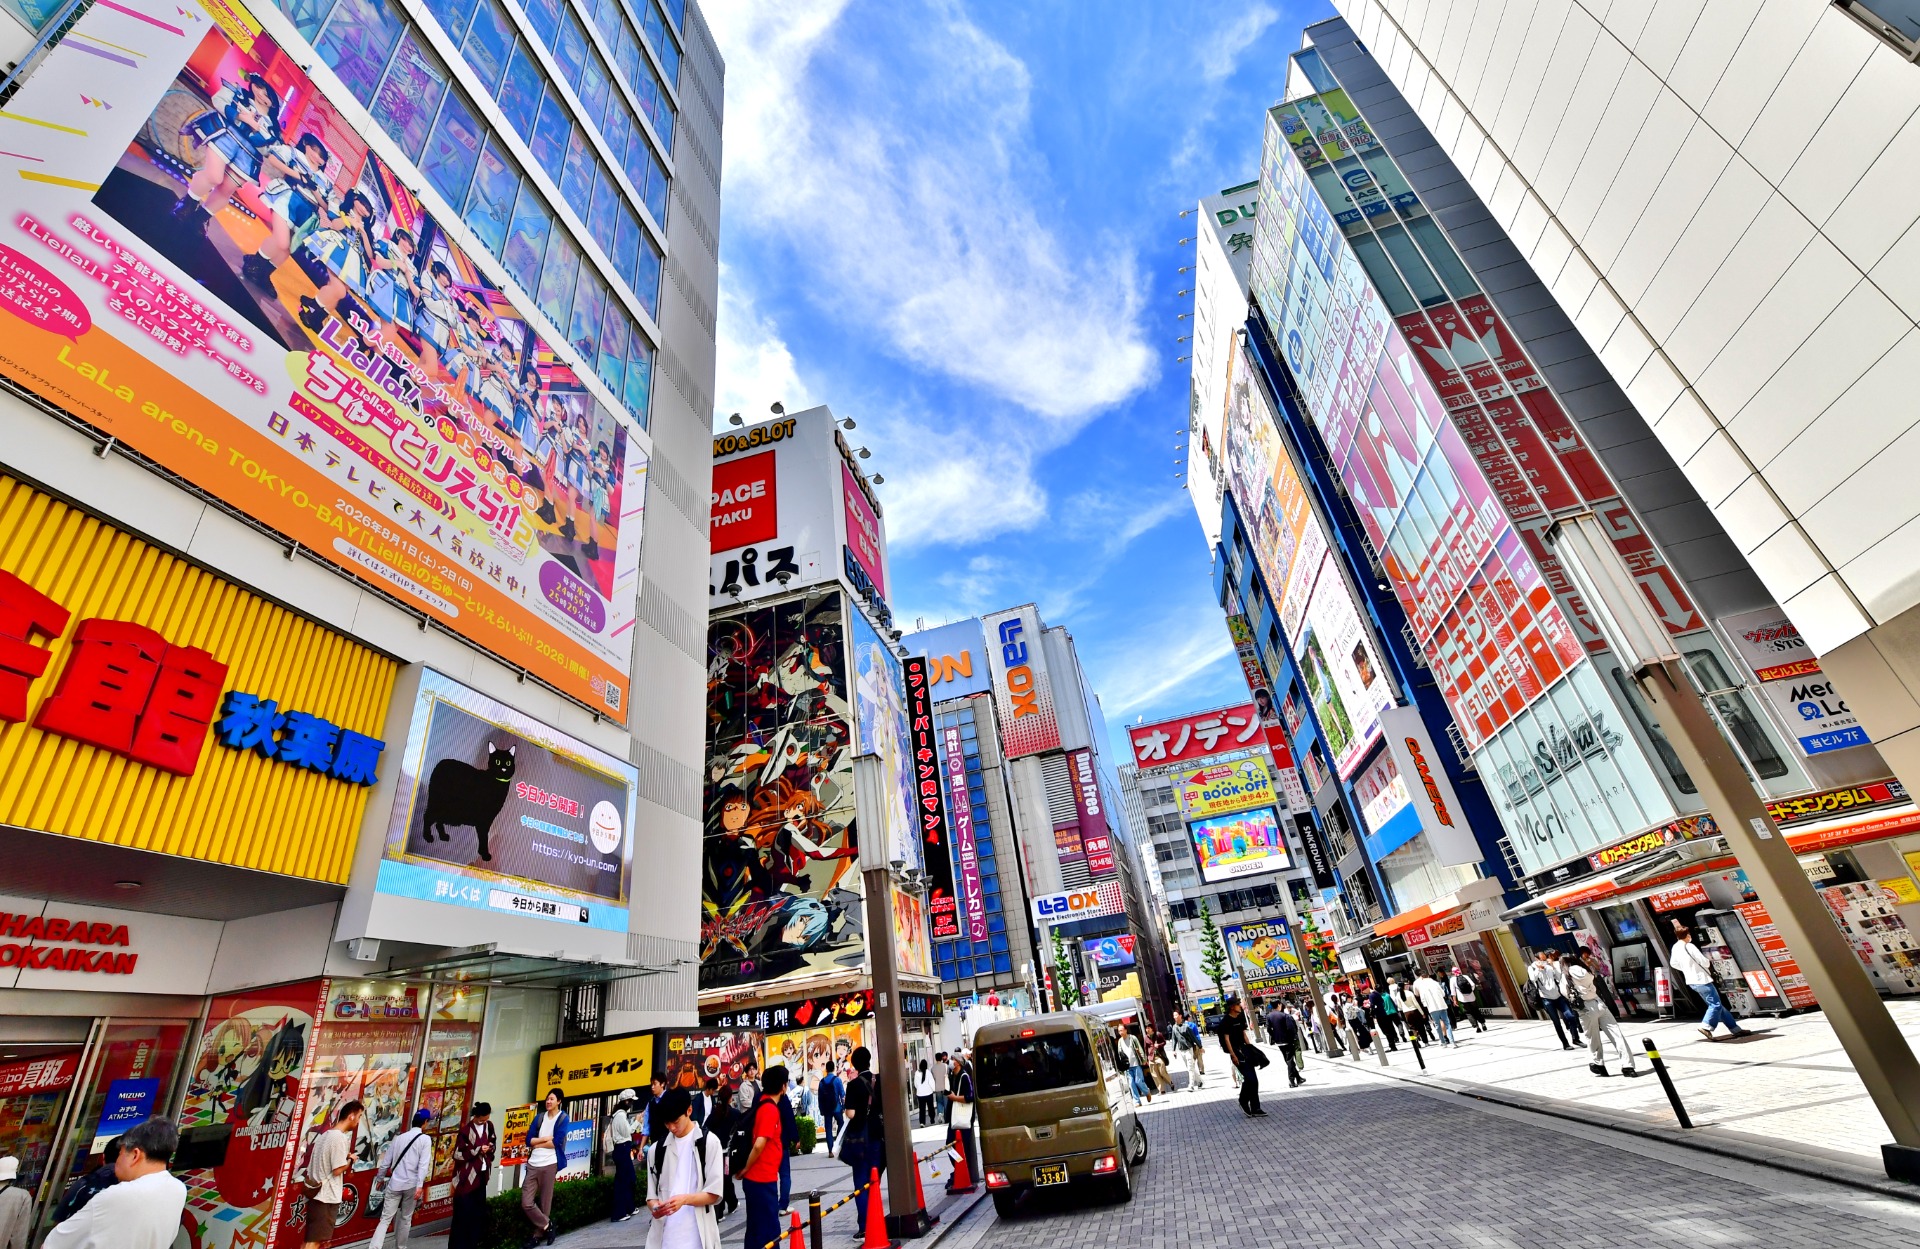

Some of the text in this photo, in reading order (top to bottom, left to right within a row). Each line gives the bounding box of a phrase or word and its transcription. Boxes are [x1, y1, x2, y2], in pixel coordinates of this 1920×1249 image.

[72, 216, 251, 351] 厳しい芸能界を生き抜く術を
[109, 297, 187, 355] さらに開発!
[57, 344, 136, 404] LaLa
[141, 399, 219, 465] arena
[212, 690, 386, 788] 秋葉原
[1135, 710, 1260, 761] オノデン
[1810, 730, 1860, 749] 当ビル 7F
[952, 774, 963, 787] 酒
[1068, 755, 1083, 803] Flagship Store
[1075, 752, 1100, 816] Duty Free
[1405, 737, 1455, 828] GAMERS
[1208, 790, 1269, 809] 現在地から徒歩4分
[958, 815, 973, 850] ゲーム
[1851, 825, 1866, 833] Card
[1866, 823, 1884, 831] Game
[1088, 838, 1108, 850] 免税
[1303, 825, 1327, 875] SNKRDUNK
[1229, 861, 1264, 874] ONODEN
[435, 880, 481, 902] 詳しくは
[966, 873, 981, 910] トレカ
[1056, 907, 1102, 921] Electronics Store
[1227, 923, 1286, 943] ONODEN
[1429, 915, 1465, 939] GAMERS
[1264, 980, 1276, 988] TAX
[568, 1057, 644, 1082] 銀座ライオン
[118, 1092, 146, 1100] MIZUHO
[107, 1112, 144, 1121] ATMコーナー
[118, 1105, 138, 1113] みずほ
[507, 1112, 530, 1120] We are
[235, 1127, 251, 1137] CARD
[271, 1122, 290, 1134] SHOP
[505, 1117, 529, 1131] Open!
[250, 1132, 287, 1151] C-LABO
